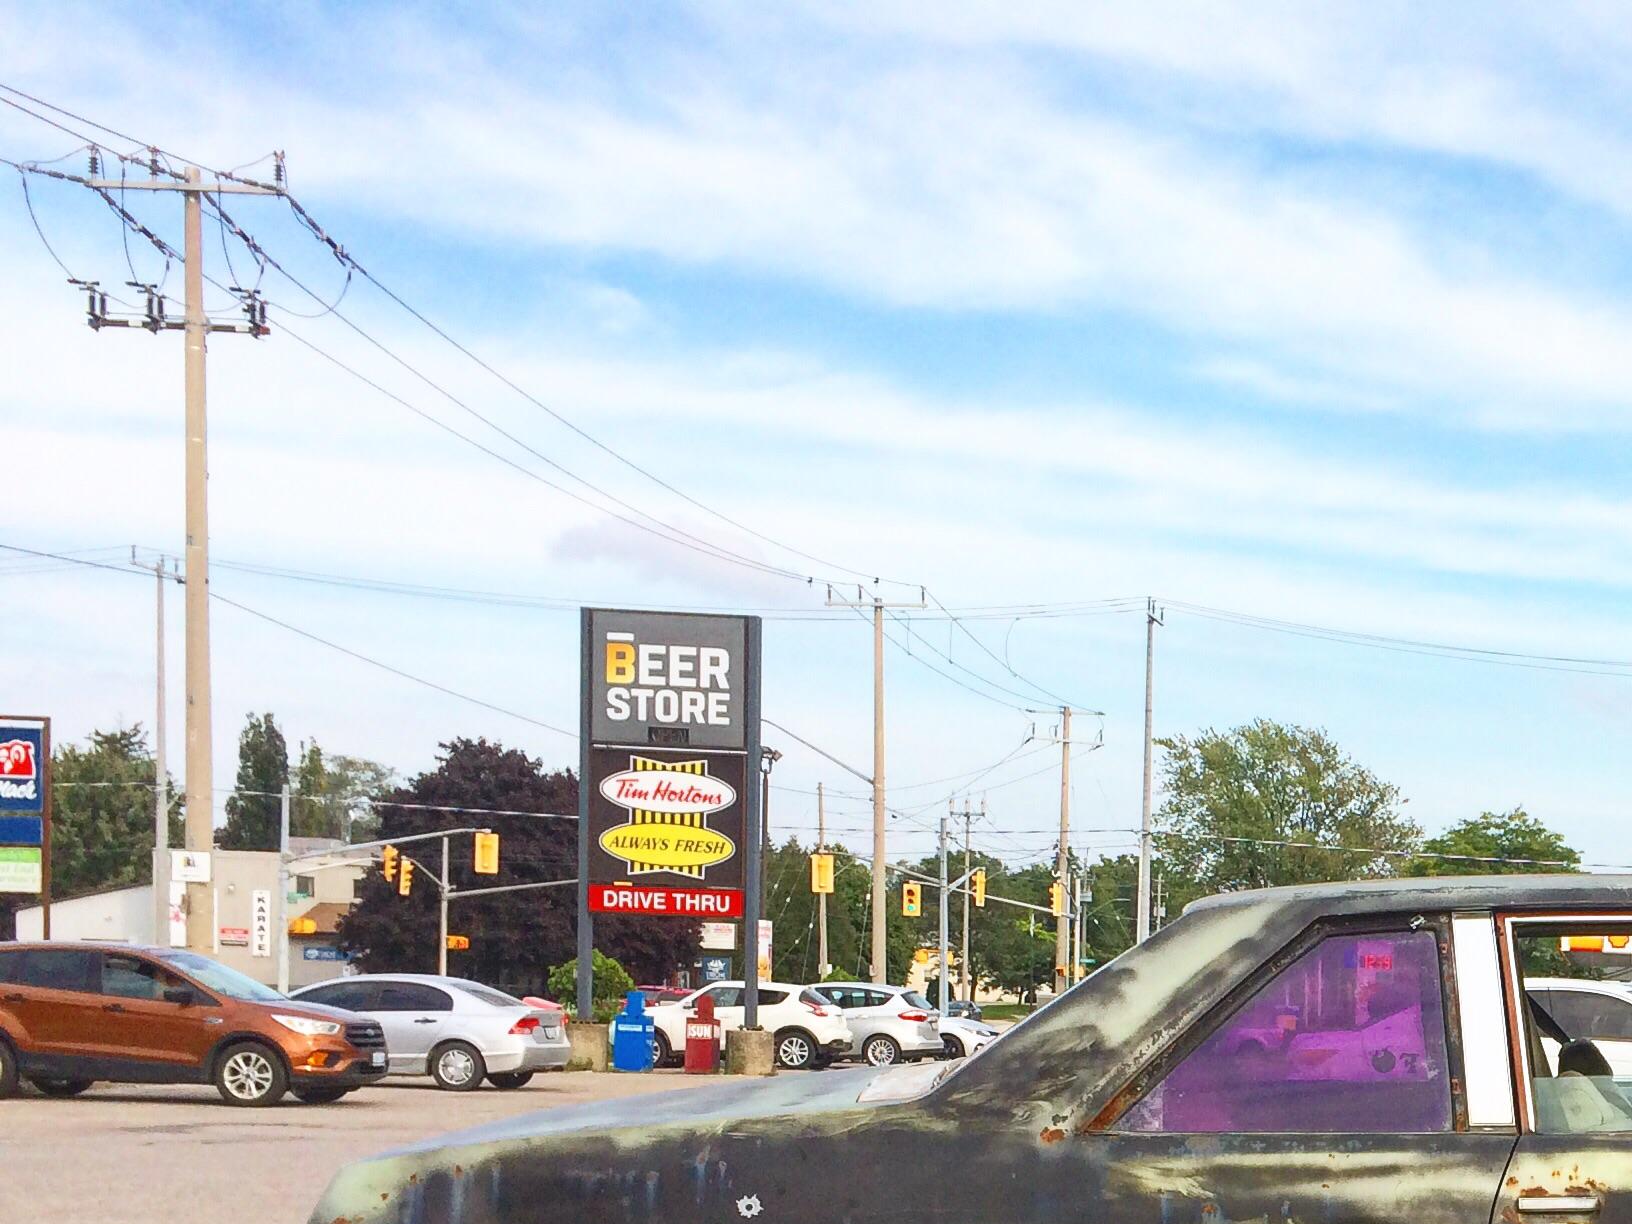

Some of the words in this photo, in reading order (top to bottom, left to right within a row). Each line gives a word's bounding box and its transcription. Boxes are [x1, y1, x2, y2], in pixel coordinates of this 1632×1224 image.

[606, 640, 730, 690] BEER
[606, 686, 730, 725] STORE
[615, 778, 649, 801] Tim
[652, 780, 722, 805] Hortons
[609, 834, 670, 851] ALWAYS
[674, 838, 726, 854] FRESH
[602, 889, 669, 910] DRIVE
[671, 892, 730, 913] THRU
[257, 896, 266, 951] KARATE
[690, 1025, 711, 1038] SUN
